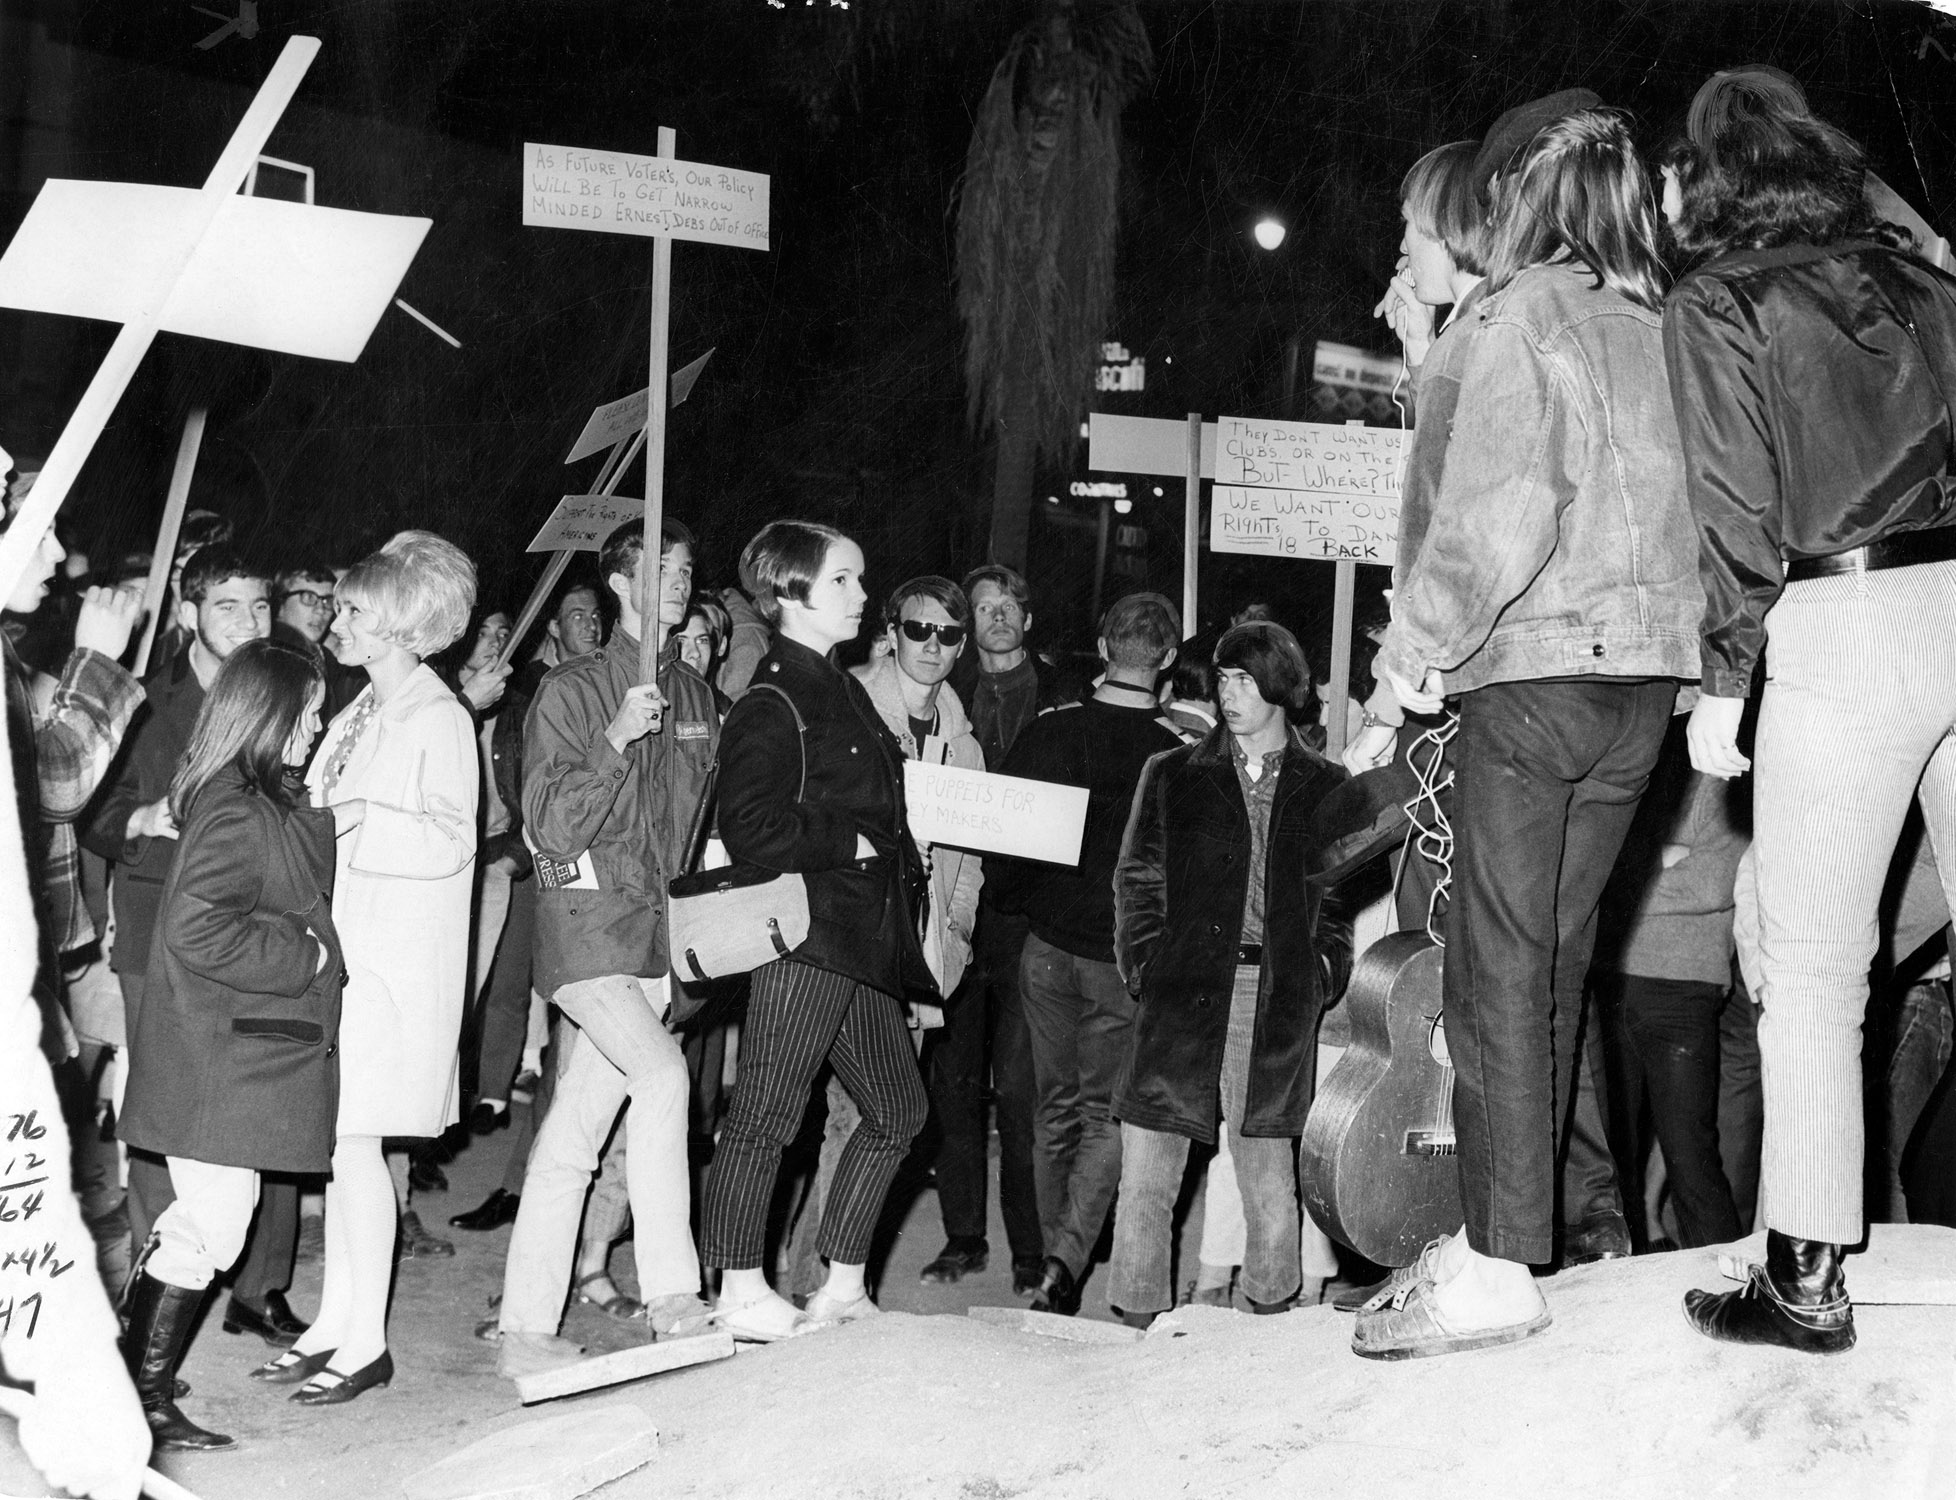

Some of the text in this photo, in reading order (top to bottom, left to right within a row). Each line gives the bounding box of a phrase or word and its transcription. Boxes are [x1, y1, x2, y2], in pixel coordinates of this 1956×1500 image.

[566, 152, 616, 175] FUTURE
[686, 170, 712, 187] OUR
[577, 178, 601, 195] BE
[635, 183, 668, 202] GET
[675, 191, 733, 212] NARROW
[533, 196, 602, 219] MINDED
[710, 217, 728, 231] OUT
[727, 220, 739, 234] OF
[1333, 431, 1377, 445] WANT
[1293, 447, 1314, 459] OR
[1323, 451, 1351, 462] ON
[1229, 490, 1400, 520] WE WANT OUR
[1302, 519, 1330, 536] TO
[1307, 537, 1378, 558] BACK
[926, 774, 994, 804] PUPPETS
[1001, 788, 1036, 814] FOR
[936, 806, 1004, 834] MAKERS
